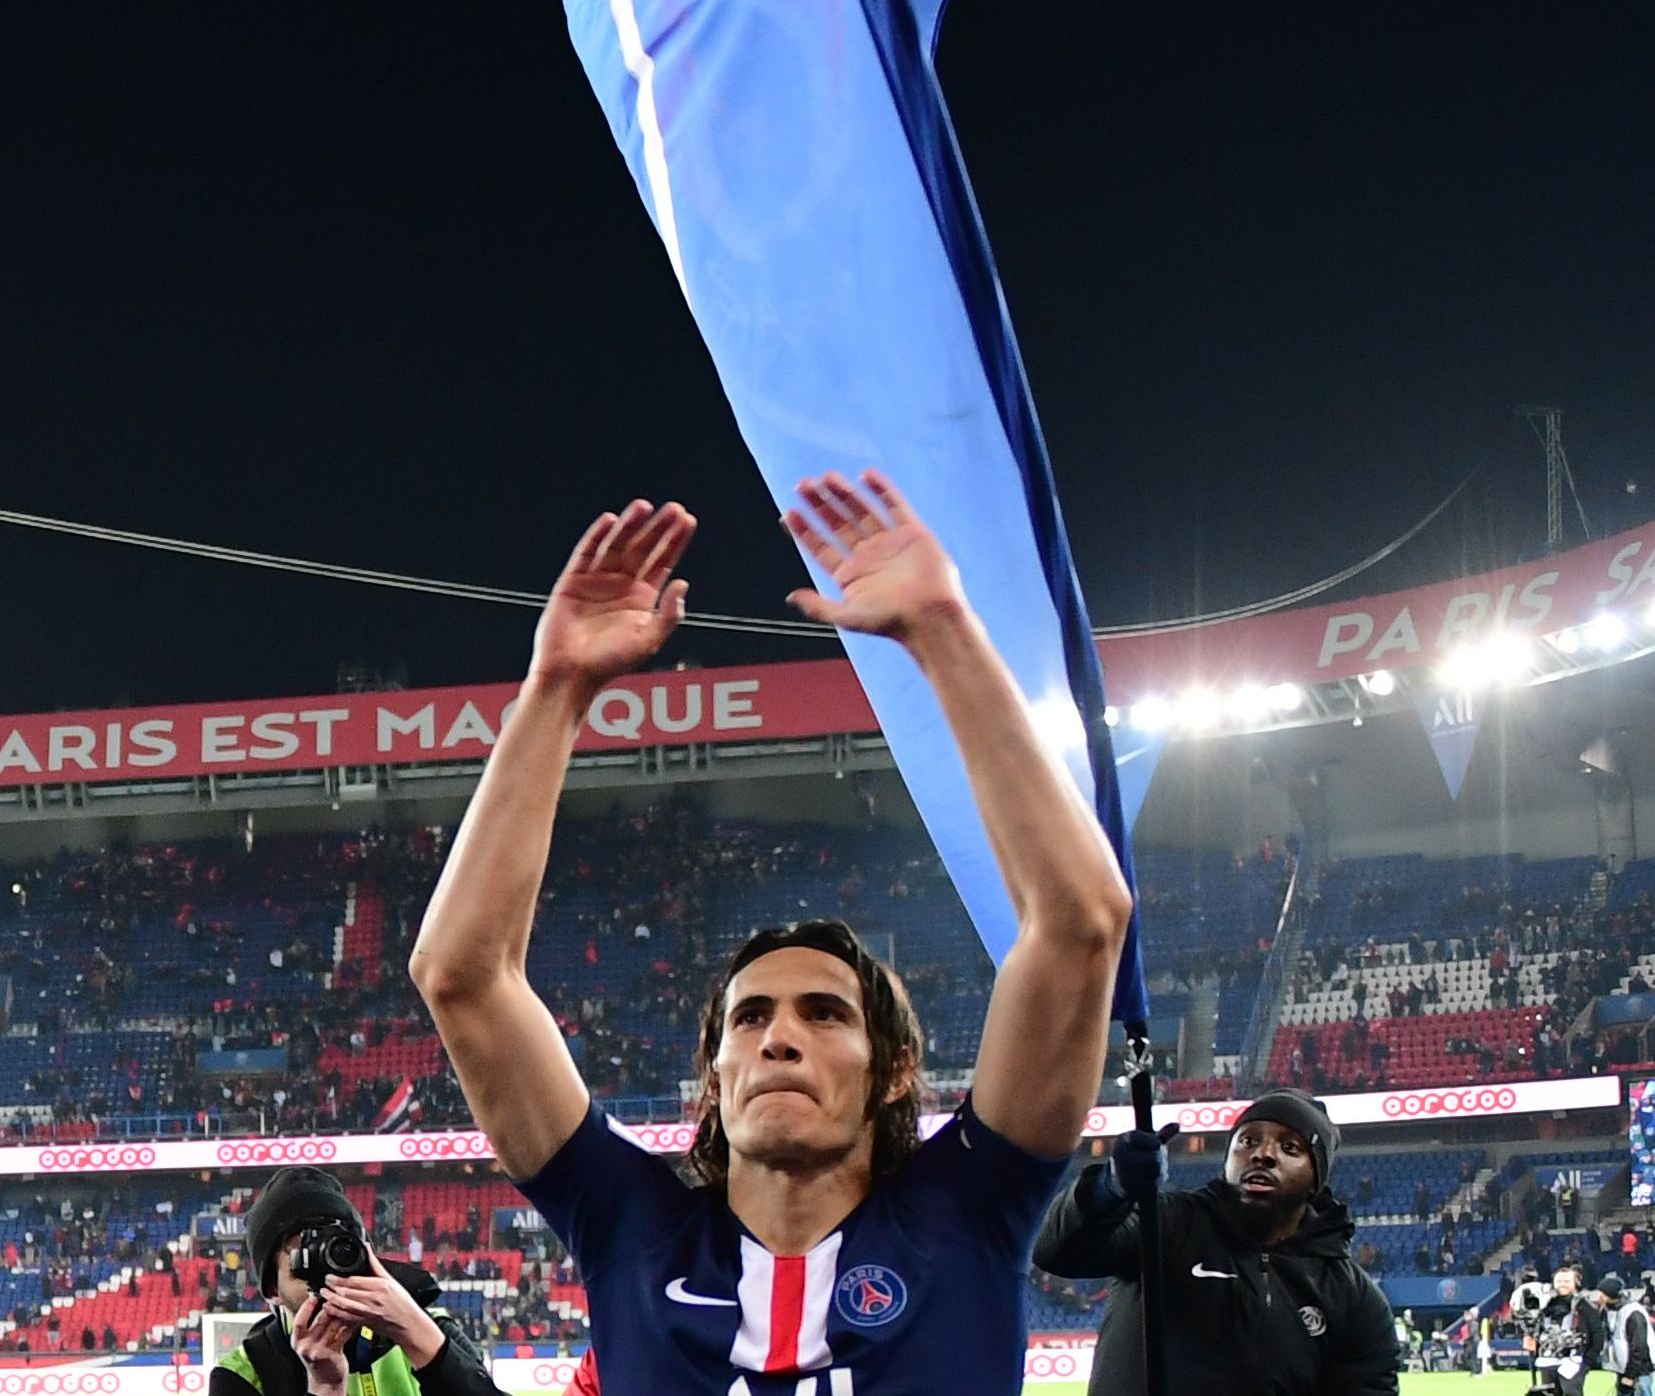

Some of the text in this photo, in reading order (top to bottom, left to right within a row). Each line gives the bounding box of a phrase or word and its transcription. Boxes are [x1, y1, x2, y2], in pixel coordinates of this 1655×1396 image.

[1317, 571, 1559, 668] PARIS
[200, 708, 349, 763] EST
[376, 679, 763, 752] MAQUE
[1383, 1088, 1517, 1117] ooredoo
[39, 1147, 156, 1169] ooredoo
[217, 1139, 338, 1163] ooredoo
[400, 1131, 501, 1158] oored
[840, 1268, 886, 1293] PARIS
